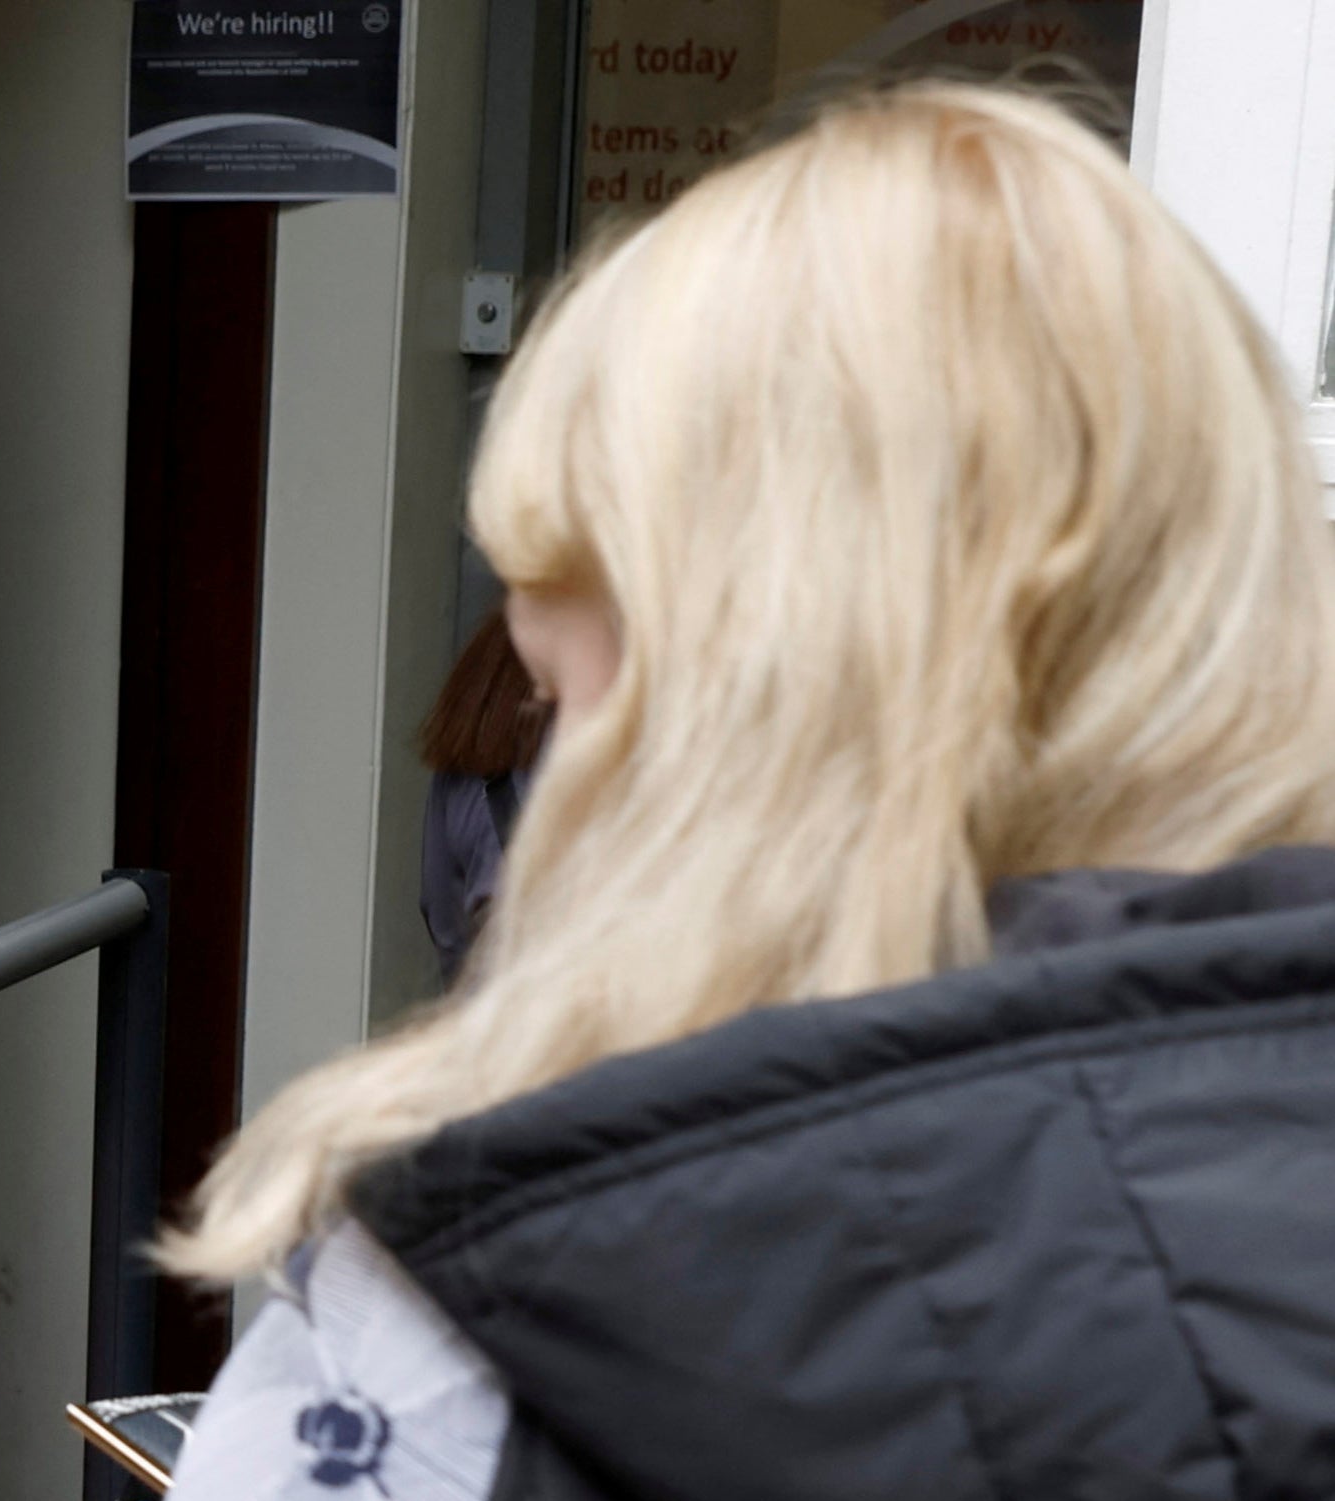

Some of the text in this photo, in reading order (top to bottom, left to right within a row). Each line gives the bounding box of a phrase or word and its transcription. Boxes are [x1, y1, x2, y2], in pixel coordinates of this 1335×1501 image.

[177, 11, 334, 39] We're hiring!!
[635, 38, 738, 83] today
[590, 122, 678, 154] tems
